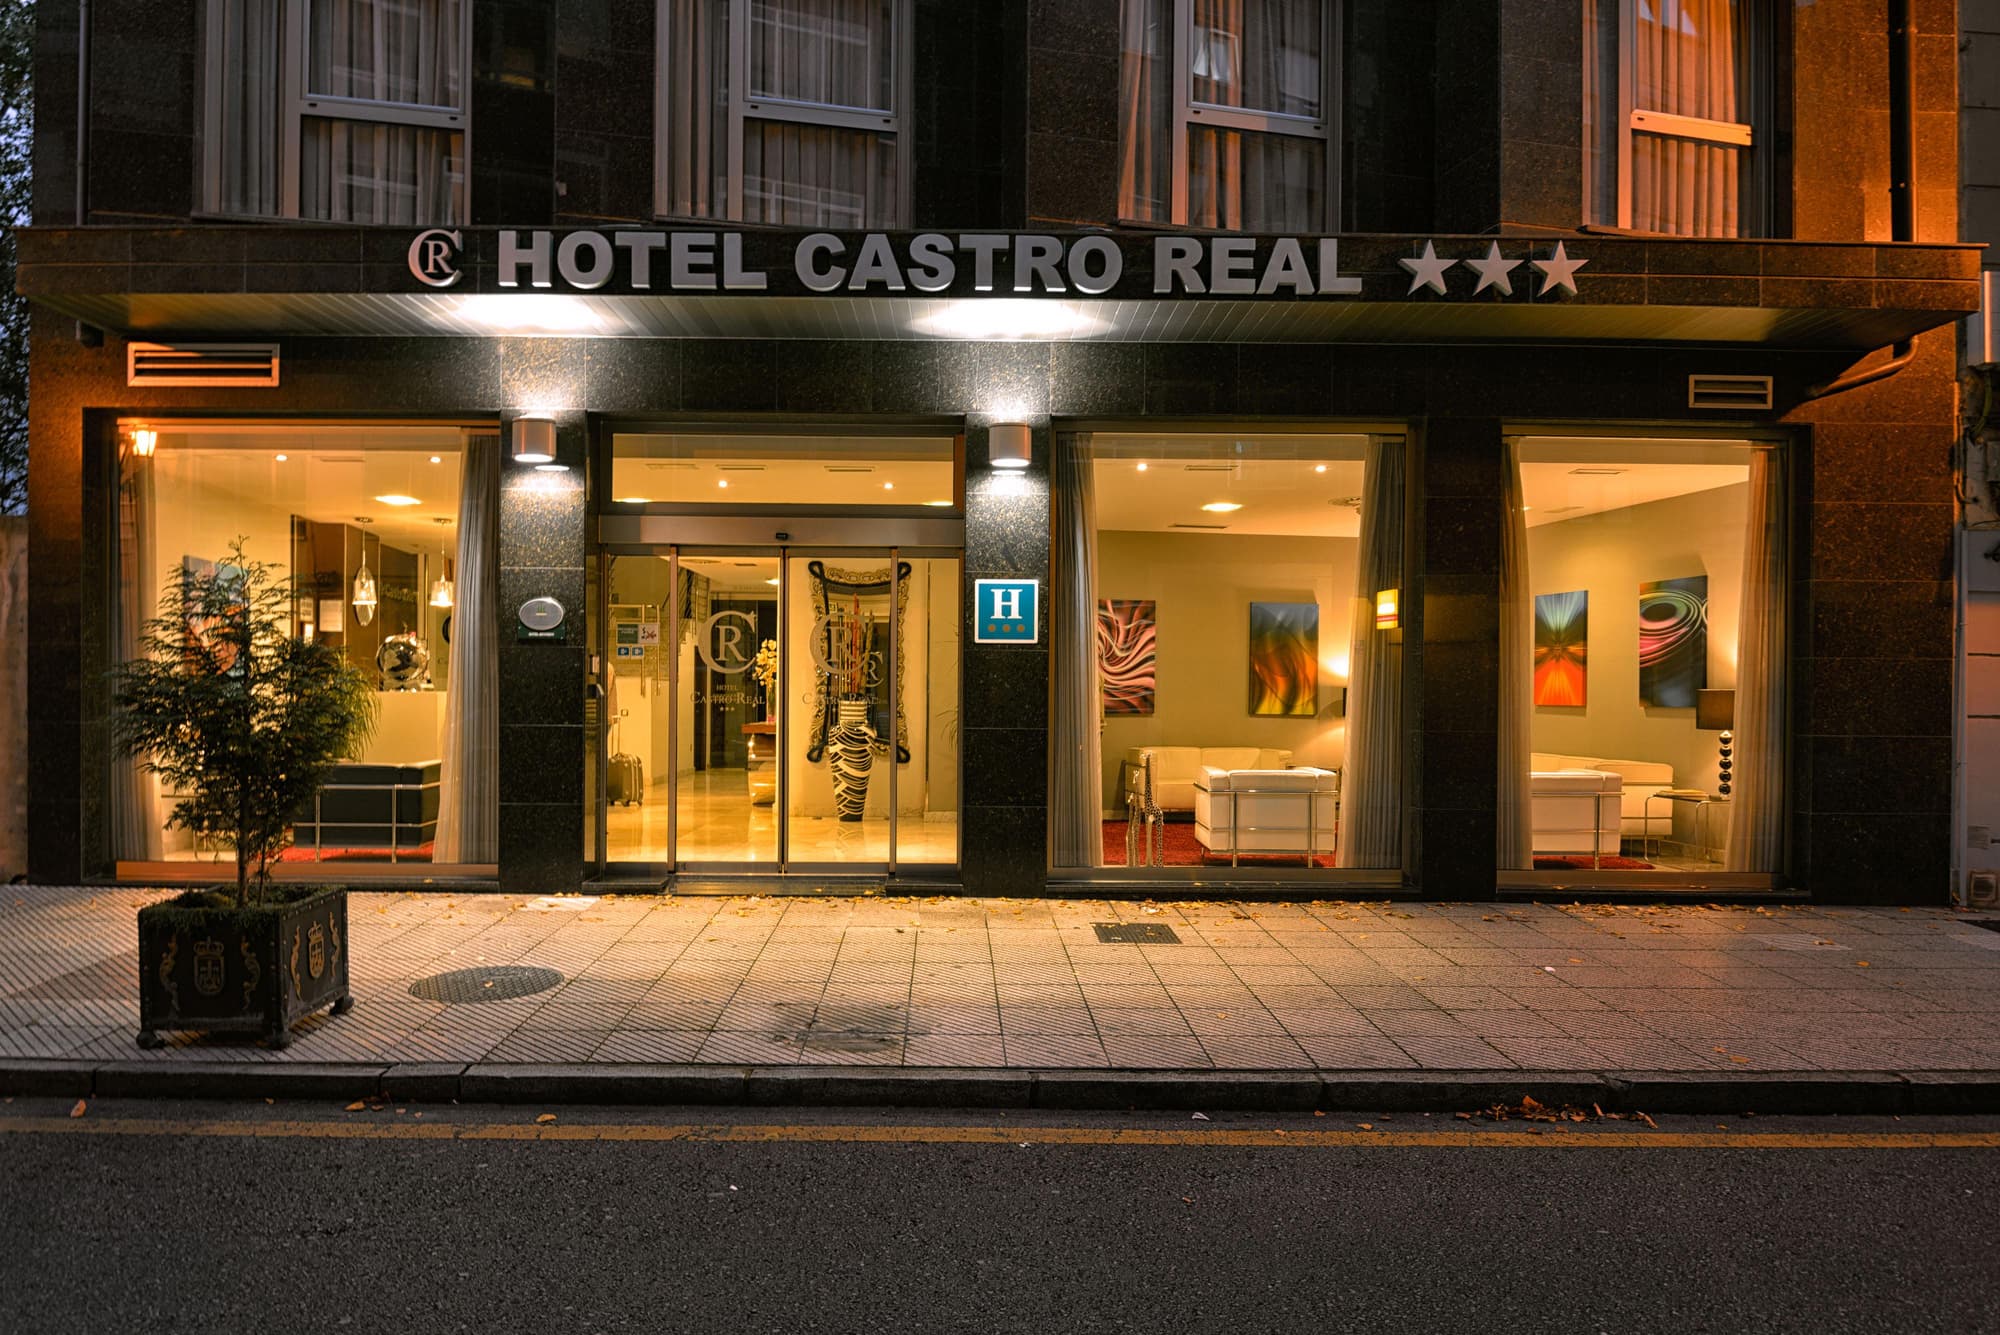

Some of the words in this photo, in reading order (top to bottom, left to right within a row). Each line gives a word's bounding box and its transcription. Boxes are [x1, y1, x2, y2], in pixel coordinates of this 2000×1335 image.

[498, 230, 767, 289] HOTEL
[794, 233, 1123, 294] CASTRO
[1153, 237, 1362, 295] REAL
[990, 588, 1023, 620] H
